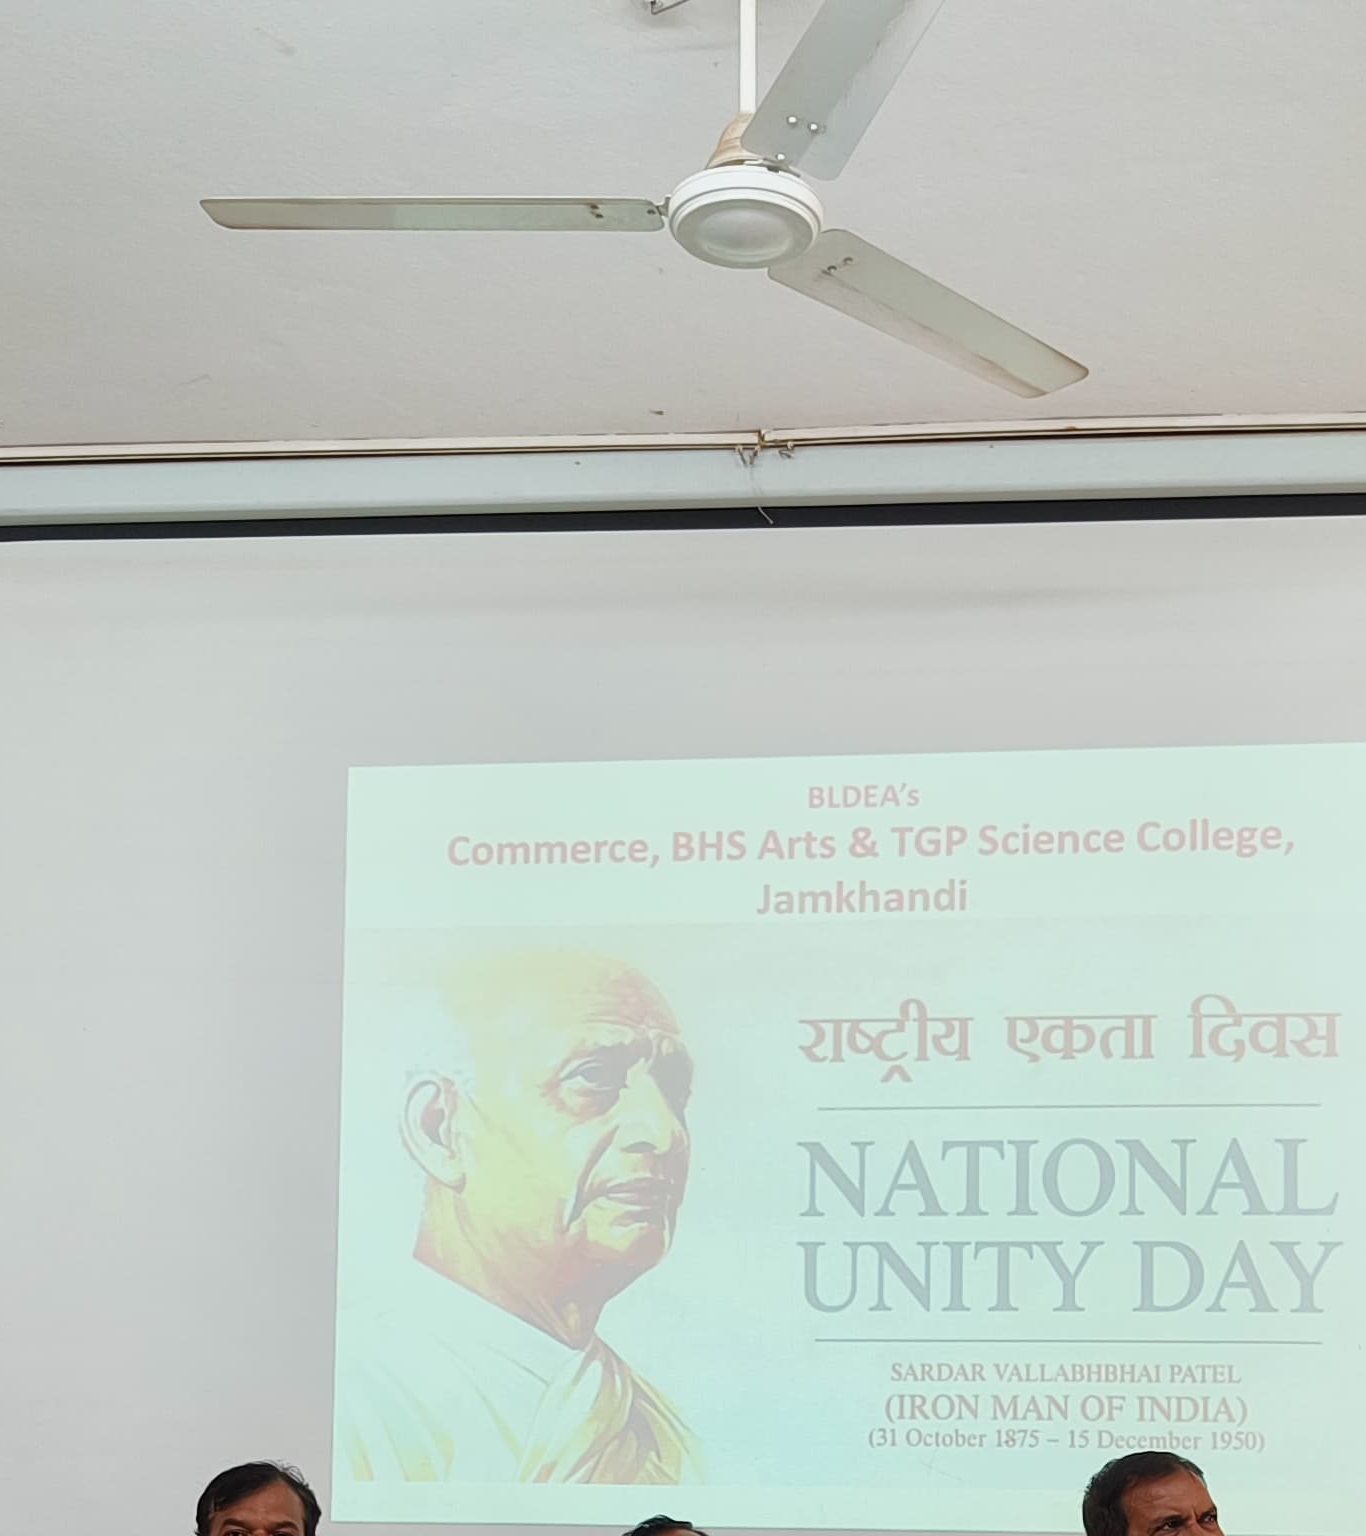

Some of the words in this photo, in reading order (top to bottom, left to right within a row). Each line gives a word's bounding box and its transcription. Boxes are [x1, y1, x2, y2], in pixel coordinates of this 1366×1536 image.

[446, 835, 660, 869] Commerce,
[671, 829, 748, 863] BHS
[756, 829, 837, 862] Arts
[848, 826, 880, 858] &
[891, 825, 969, 857] TGP
[978, 823, 1125, 856] Science
[1136, 817, 1295, 859] College,
[756, 877, 969, 916] Jamkhandi
[797, 996, 975, 1083] राष्ट्रीय
[1005, 1013, 1159, 1063] एकता
[1187, 993, 1342, 1062] दिवस
[795, 1136, 1340, 1218] NATIONAL
[795, 1240, 1105, 1313] UNITY
[1132, 1239, 1344, 1313] DAY
[890, 1362, 988, 1384] SARDAR
[992, 1362, 1163, 1385] VALLABHBHAI
[1169, 1363, 1243, 1385] PATEL
[884, 1394, 980, 1424] (IRON
[991, 1395, 1070, 1421] MAN
[1080, 1394, 1128, 1422] OF
[1137, 1395, 1249, 1426] INDIA)
[867, 1428, 899, 1449] (31
[904, 1429, 987, 1449] October
[995, 1429, 1040, 1449] 1875
[1067, 1431, 1090, 1449] 15
[1096, 1430, 1202, 1451] December
[1210, 1431, 1266, 1454] 1950)
